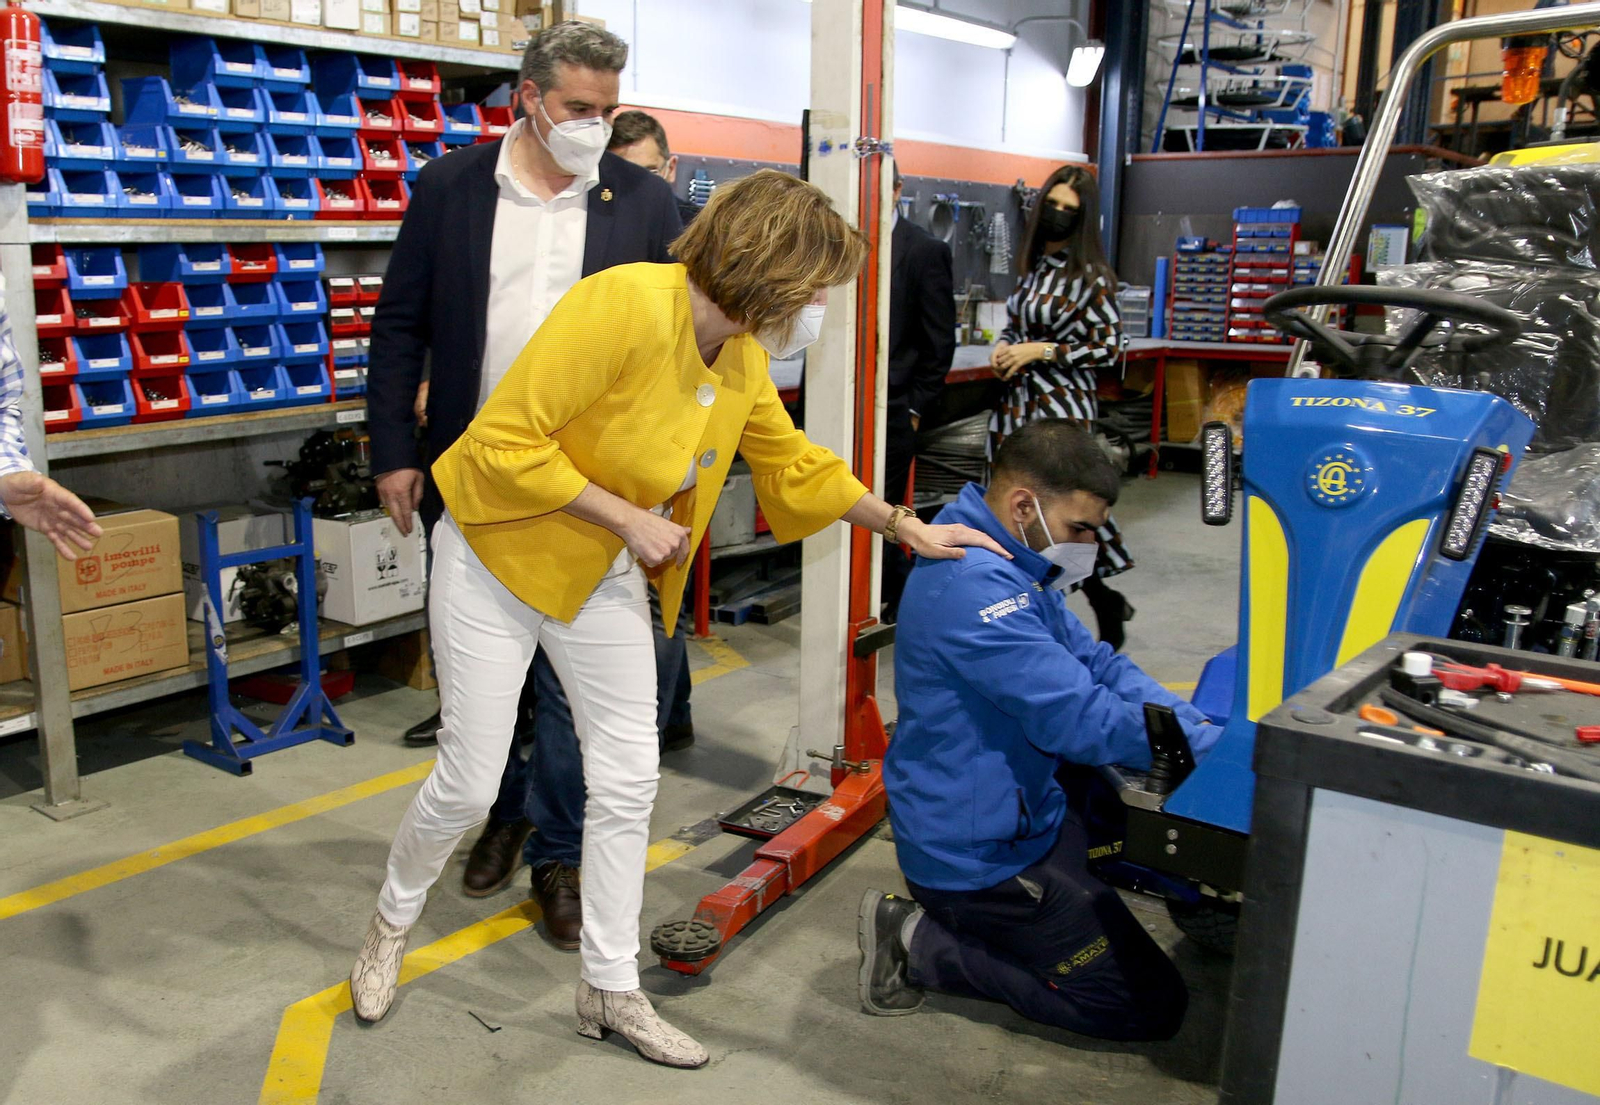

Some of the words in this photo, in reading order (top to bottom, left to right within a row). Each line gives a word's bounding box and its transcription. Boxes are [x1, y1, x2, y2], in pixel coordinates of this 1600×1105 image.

[1290, 396, 1388, 412] TIZONA
[1396, 404, 1437, 418] 37
[103, 544, 161, 562] imovilli
[111, 556, 156, 571] pompe
[95, 587, 117, 599] MADE
[119, 585, 127, 594] IN
[128, 582, 147, 593] ITALY
[103, 663, 124, 675] MADE
[125, 662, 133, 671] IN
[134, 658, 154, 669] ITALY
